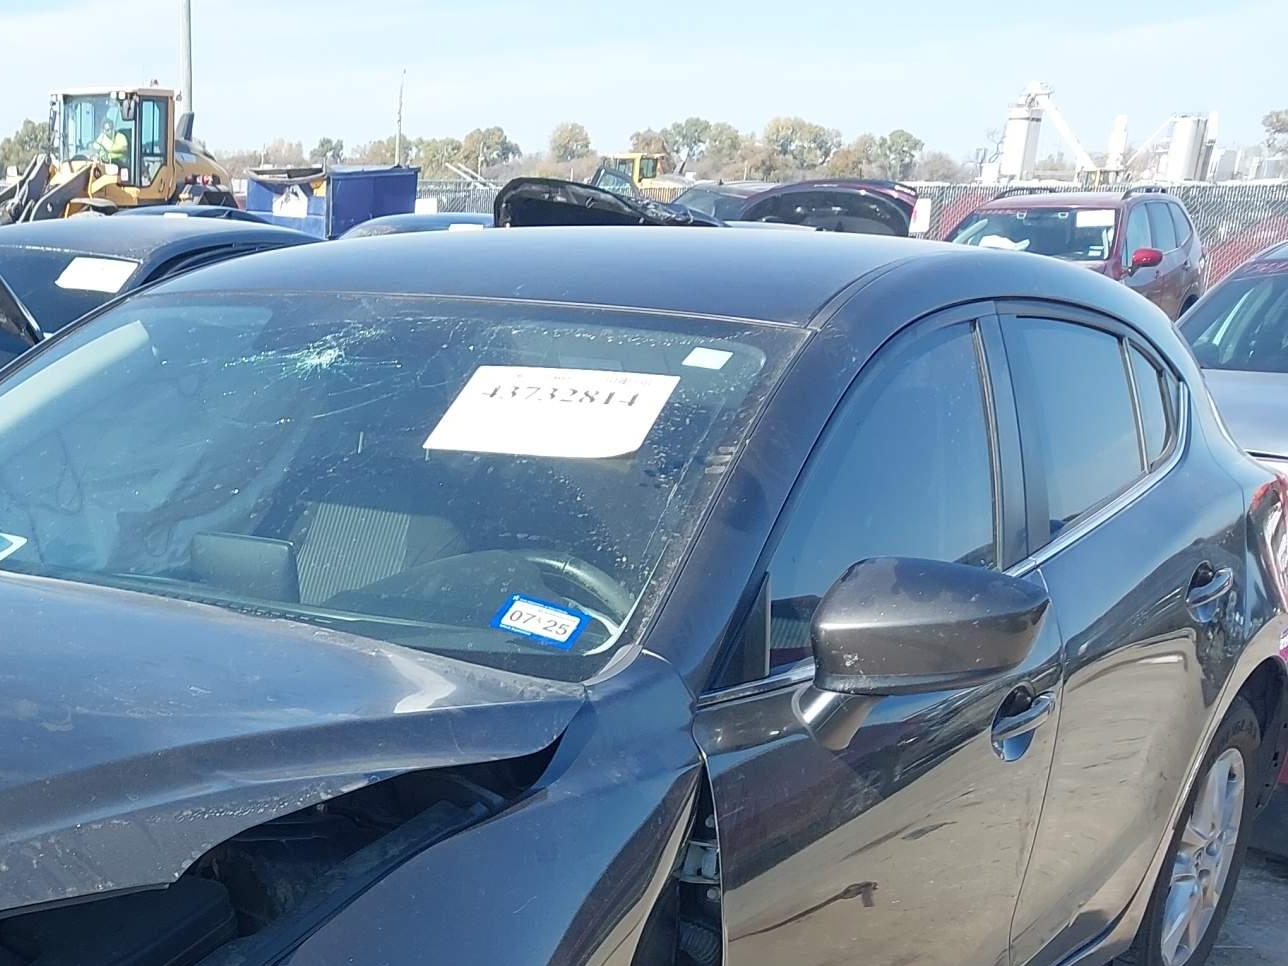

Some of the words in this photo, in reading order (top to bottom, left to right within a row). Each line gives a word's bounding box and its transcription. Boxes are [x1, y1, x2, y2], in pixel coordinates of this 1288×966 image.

[481, 384, 640, 407] 43732814
[509, 609, 537, 624] 07
[542, 619, 570, 636] 25
